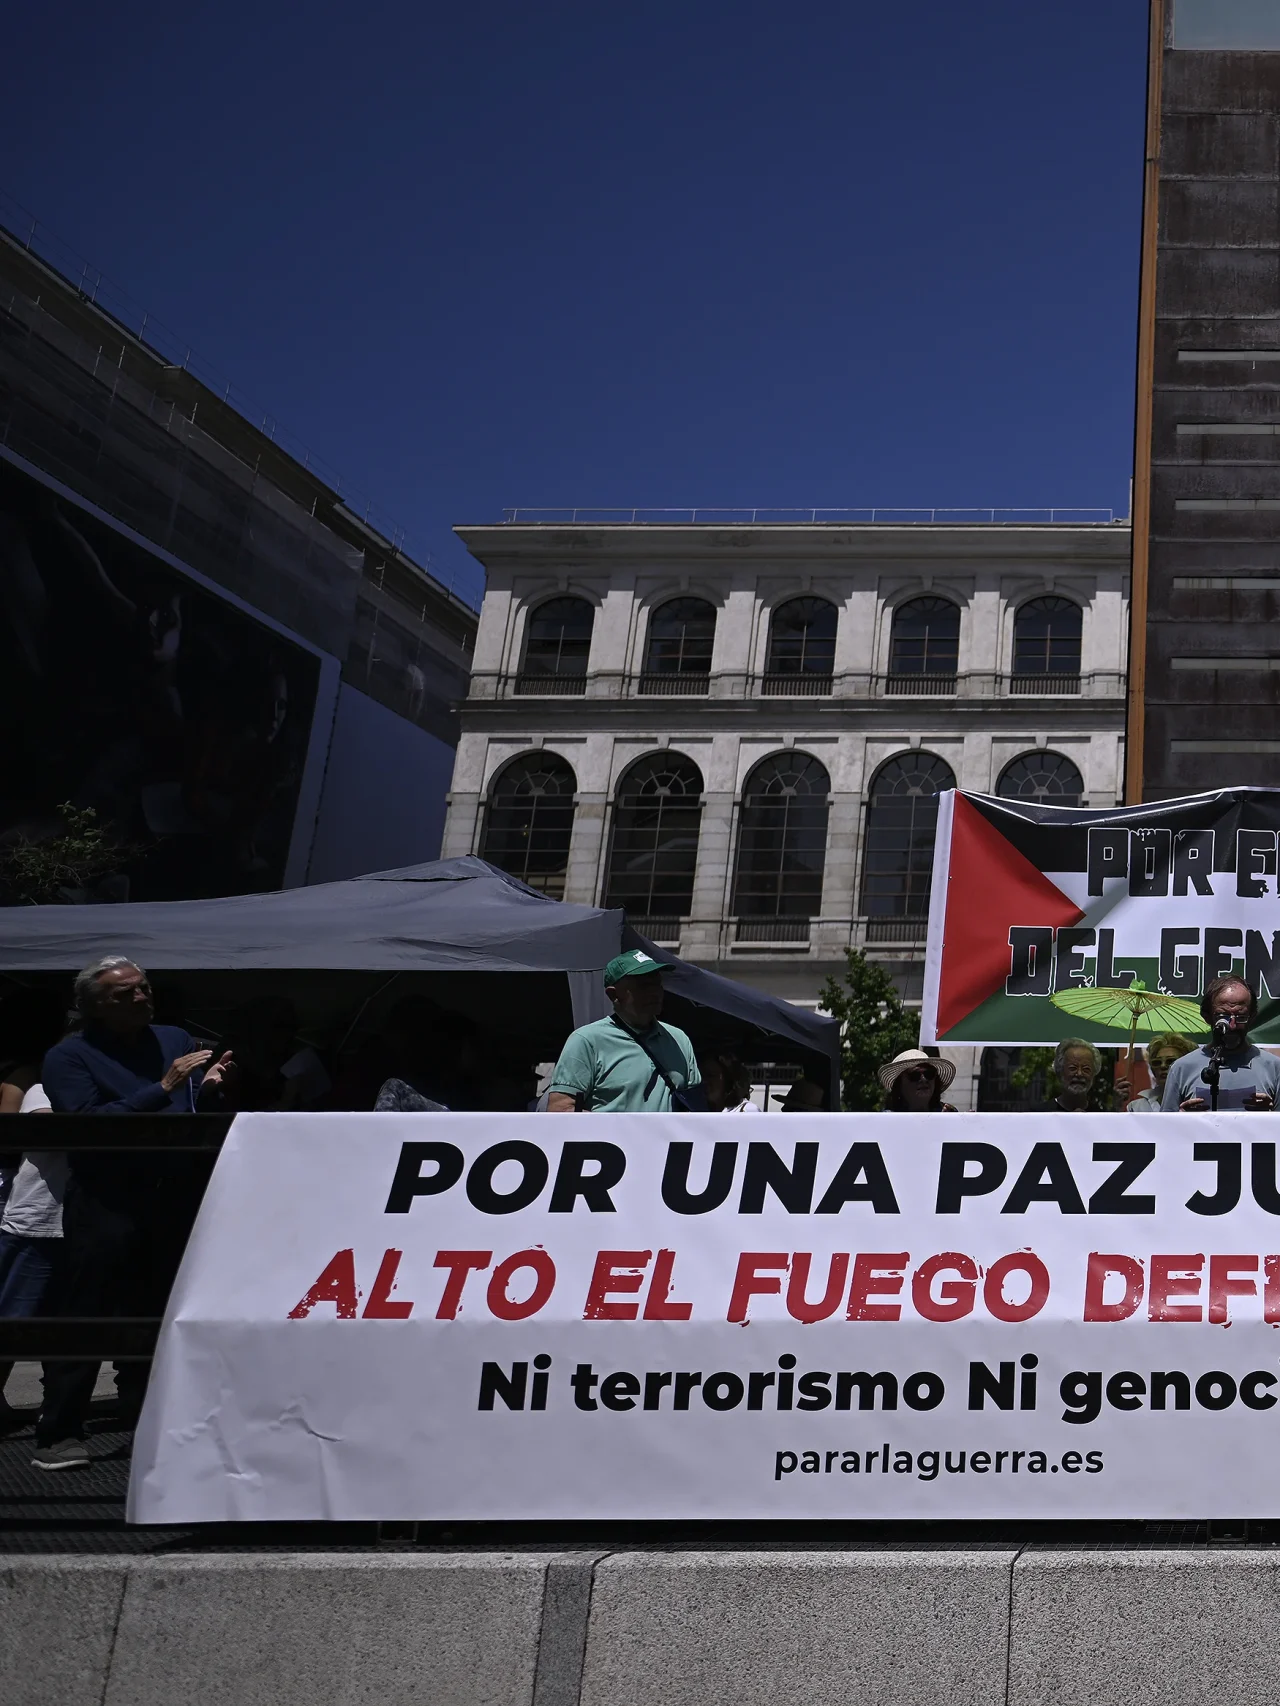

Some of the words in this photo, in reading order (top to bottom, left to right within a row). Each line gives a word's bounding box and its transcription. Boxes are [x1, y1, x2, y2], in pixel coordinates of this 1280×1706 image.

[1087, 827, 1215, 897] POR
[1005, 926, 1137, 998] DEL
[383, 1139, 627, 1215] POR
[661, 1141, 901, 1216] UNA
[935, 1142, 1156, 1215] PAZ
[289, 1246, 556, 1322] ALTO
[583, 1248, 693, 1322] EL
[727, 1248, 1050, 1328] FUEGO
[477, 1353, 552, 1411] Ni
[570, 1353, 945, 1412] terrorismo
[968, 1353, 1039, 1411] Ni
[774, 1443, 1104, 1481] pararlaguerra.es
